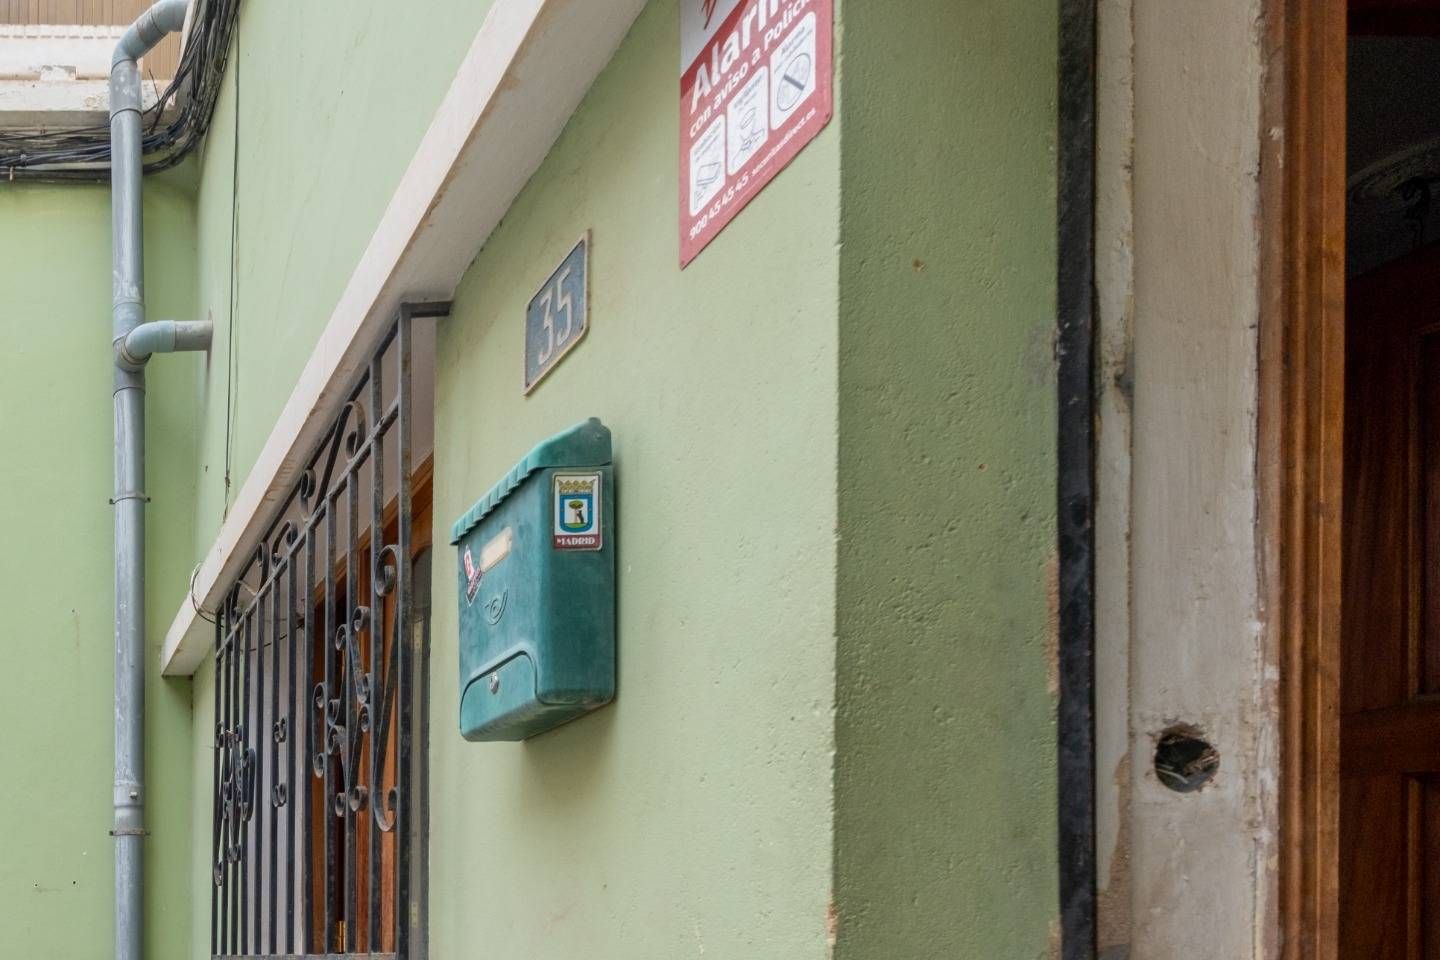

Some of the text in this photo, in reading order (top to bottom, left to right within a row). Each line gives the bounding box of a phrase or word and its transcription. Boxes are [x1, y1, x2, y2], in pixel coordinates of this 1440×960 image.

[689, 105, 712, 138] con
[713, 61, 749, 110] aviso
[751, 47, 761, 67] a
[689, 213, 708, 241] 900
[538, 266, 572, 365] 35
[556, 537, 596, 545] MADRID
